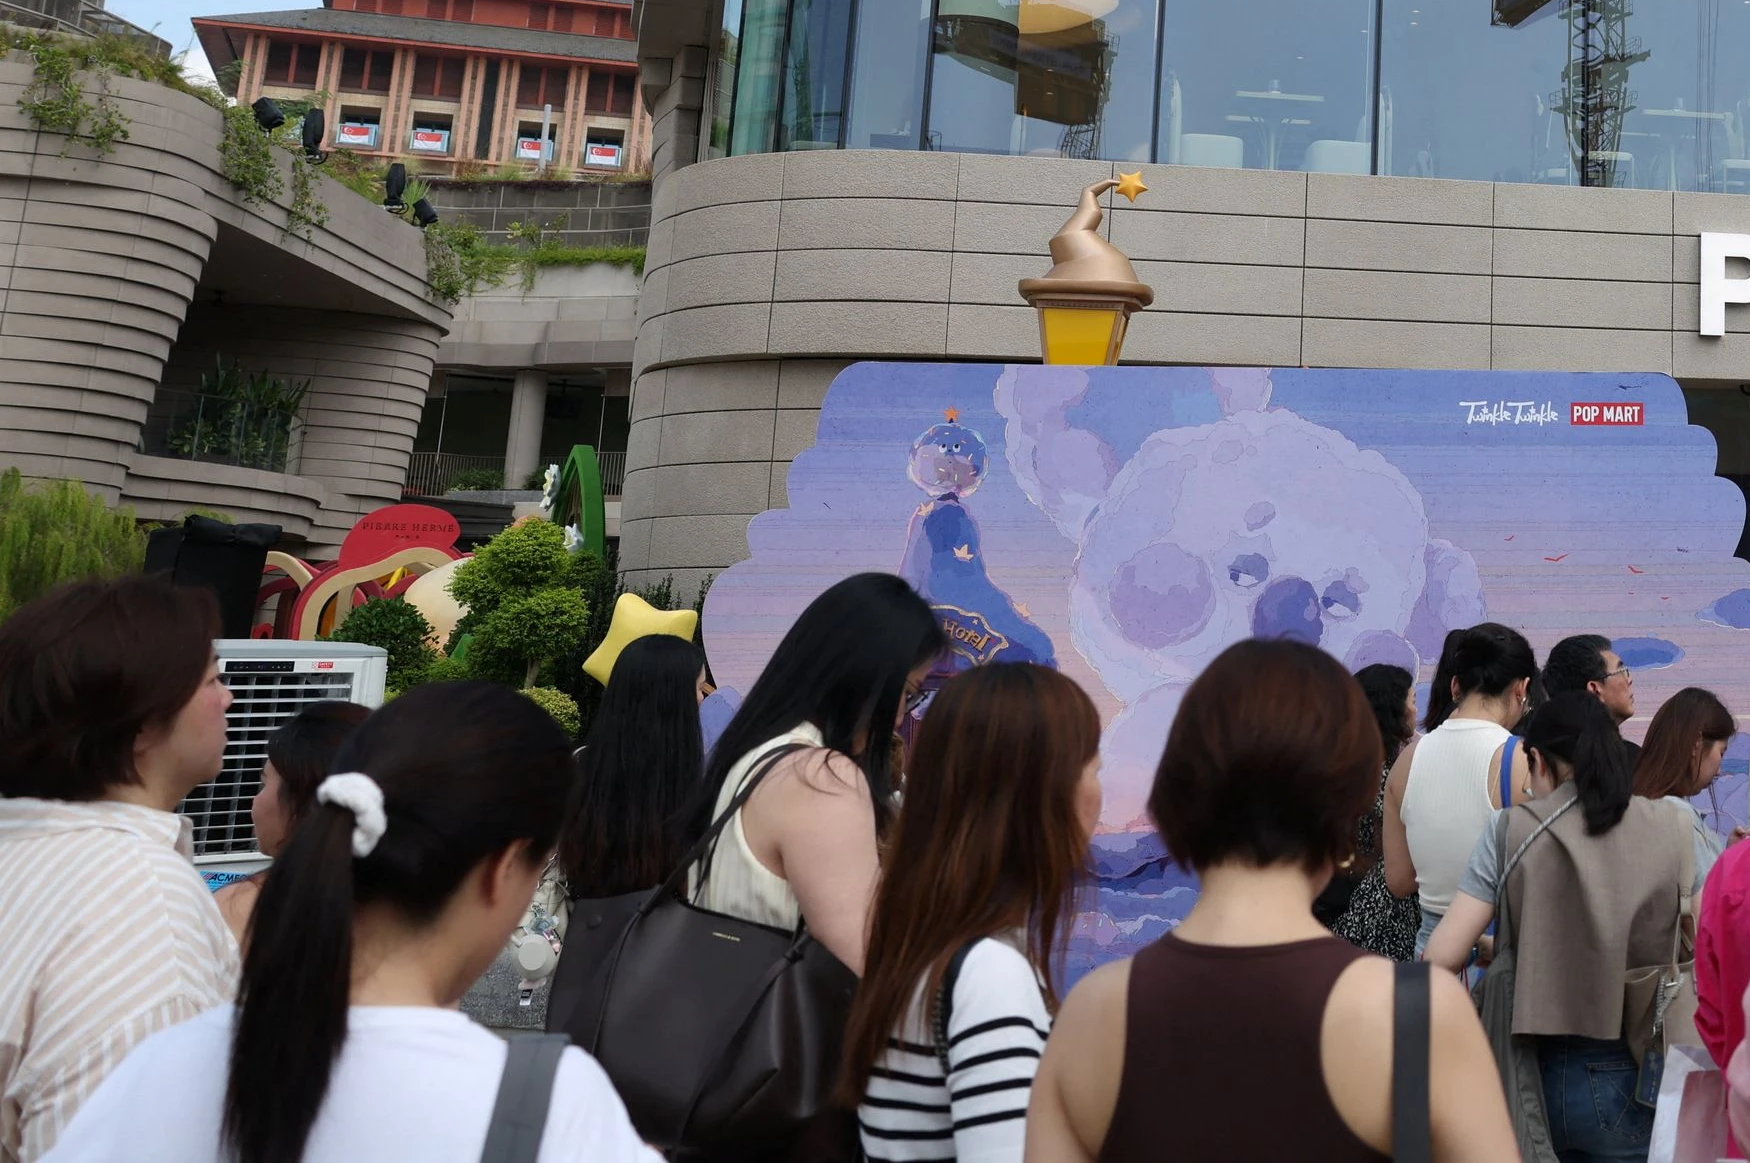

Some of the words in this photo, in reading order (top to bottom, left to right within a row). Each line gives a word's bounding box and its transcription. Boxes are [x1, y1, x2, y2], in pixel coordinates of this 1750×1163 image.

[1459, 400, 1511, 426] Twinkle
[1507, 400, 1559, 426] Twinkle
[1573, 405, 1600, 423] POP
[1603, 405, 1641, 423] MART
[362, 522, 407, 532] PIERRE
[941, 618, 991, 652] Hotel
